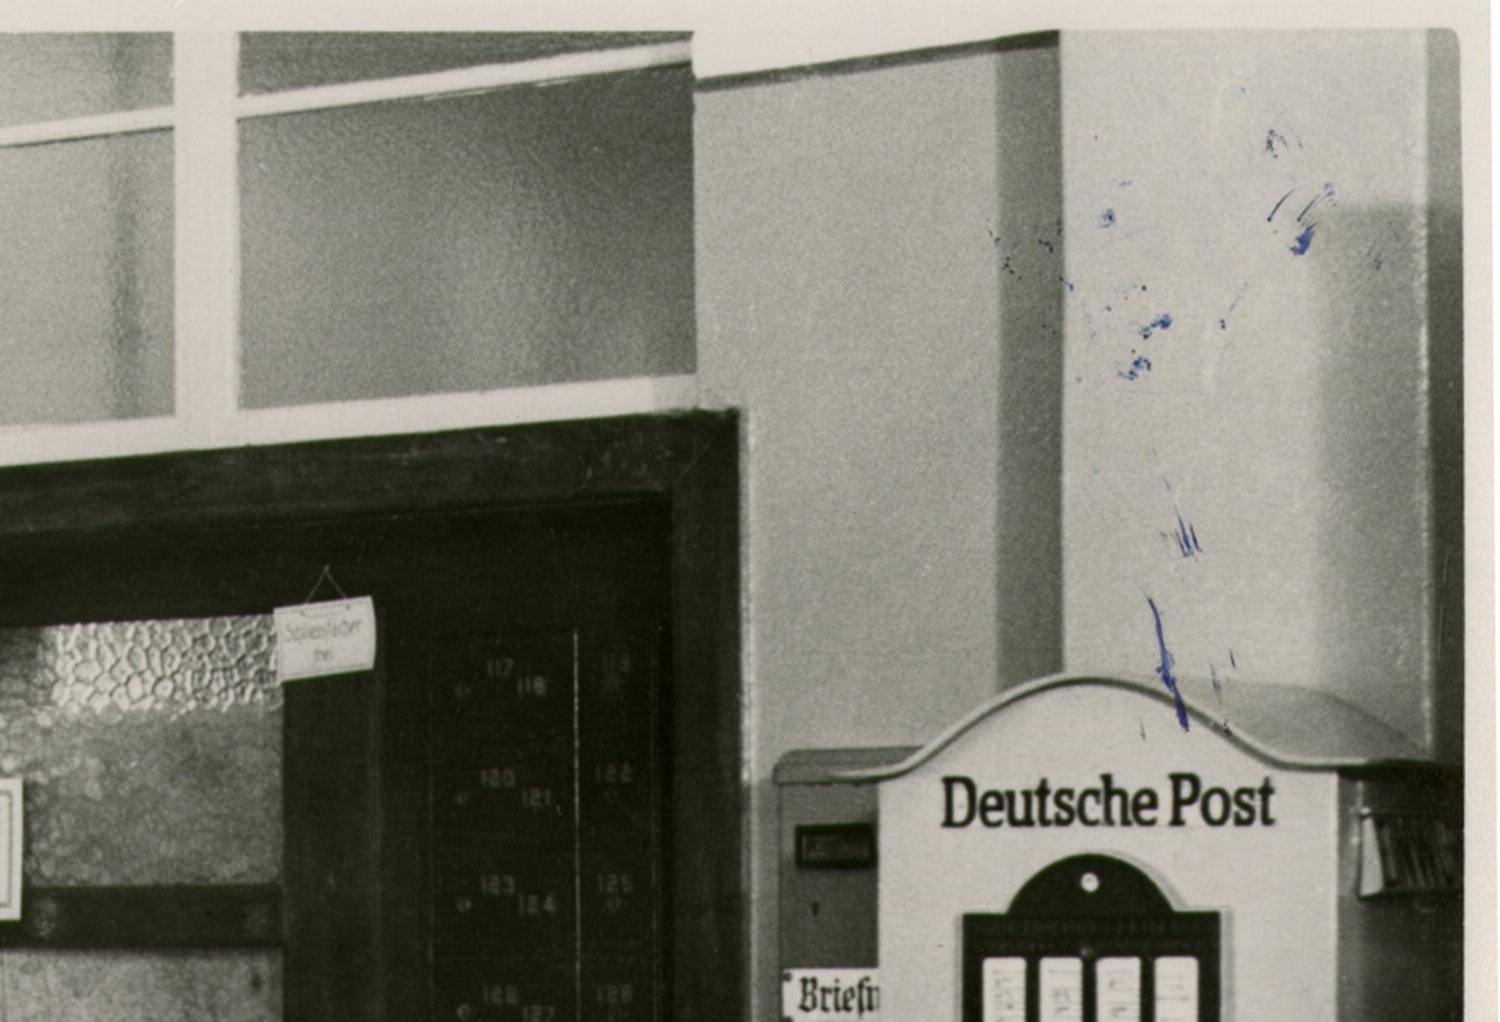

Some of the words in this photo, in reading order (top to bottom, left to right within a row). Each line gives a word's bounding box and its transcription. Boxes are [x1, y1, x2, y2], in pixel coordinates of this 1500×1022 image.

[486, 657, 515, 679] 117
[480, 767, 516, 788] 120
[595, 762, 633, 783] 122
[521, 788, 551, 810] 121
[940, 773, 1158, 829] Deutsche
[1168, 771, 1277, 828] Post
[480, 874, 516, 895] 123
[598, 873, 634, 893] 125
[518, 893, 557, 915] 124
